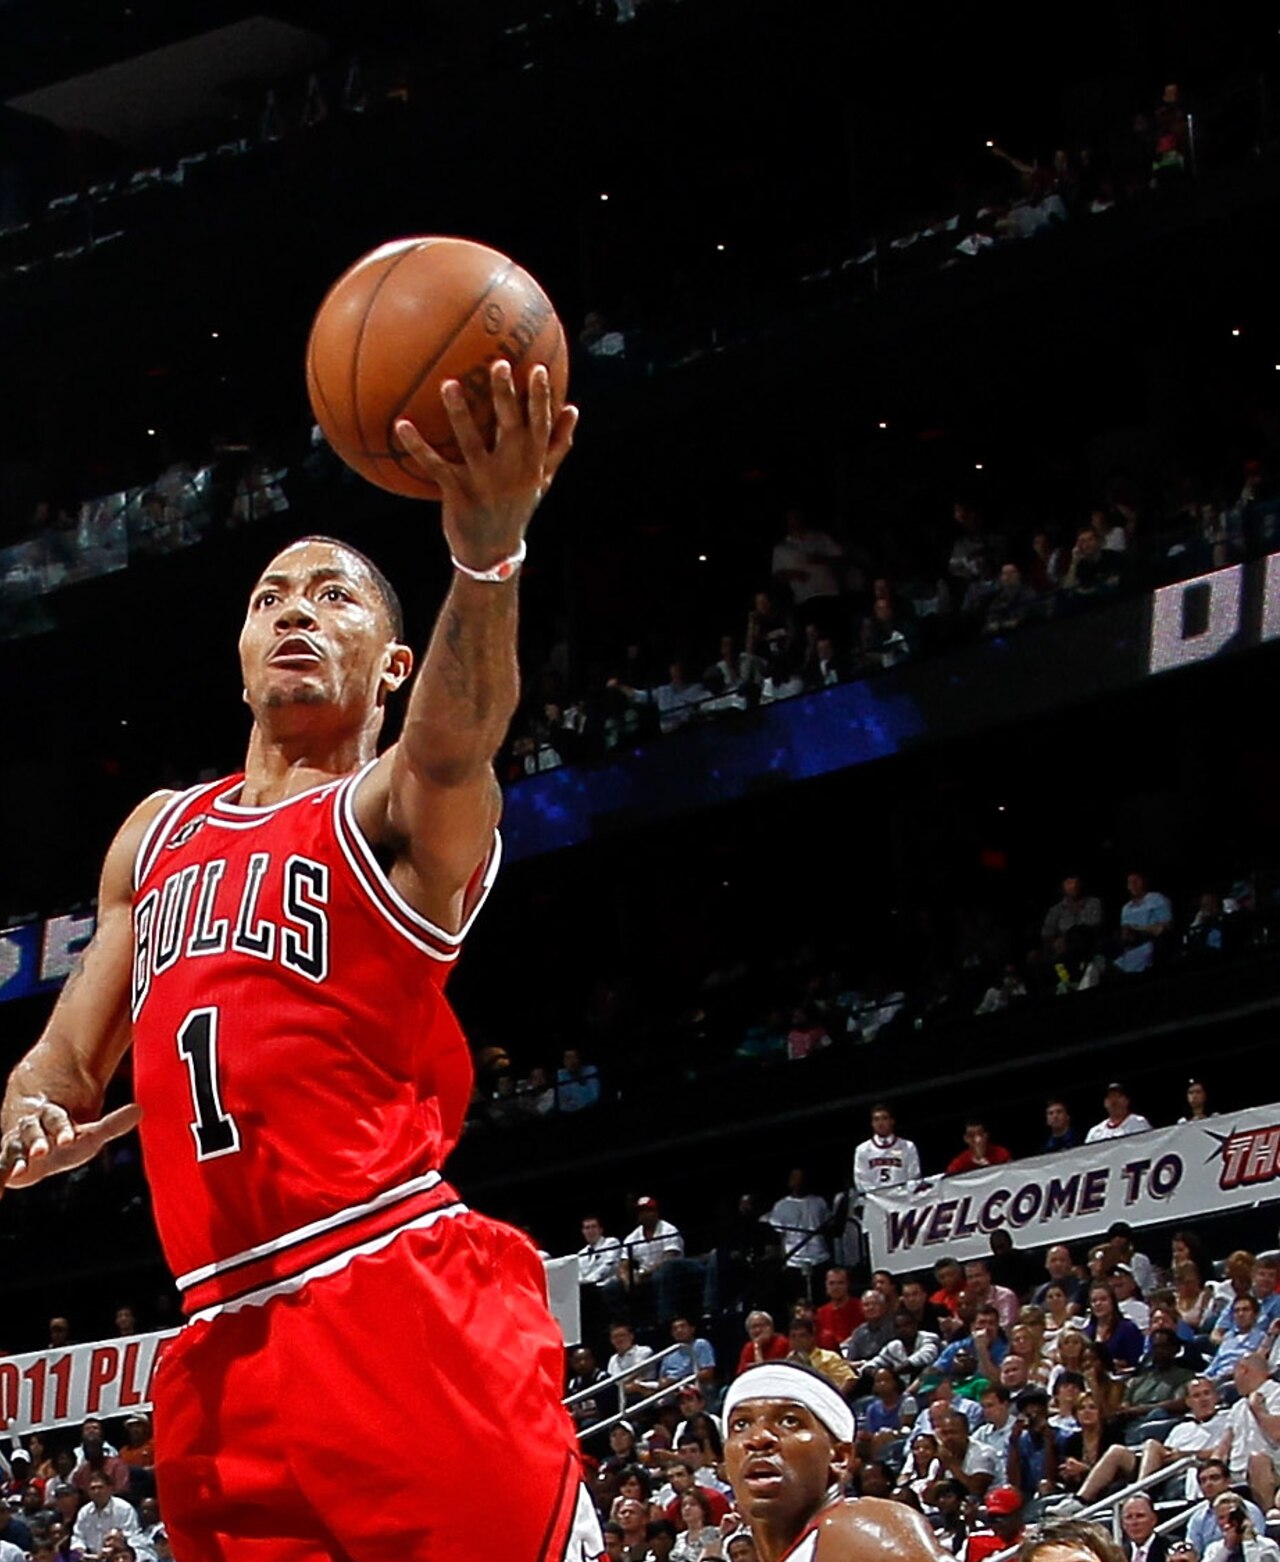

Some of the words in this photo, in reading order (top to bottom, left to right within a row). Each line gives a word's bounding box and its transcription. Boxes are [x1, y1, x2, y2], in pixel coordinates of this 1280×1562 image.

[131, 852, 329, 1023] BULLS
[177, 1006, 241, 1161] 1
[887, 1168, 1111, 1254] WELCOME
[1122, 1152, 1185, 1205] TO
